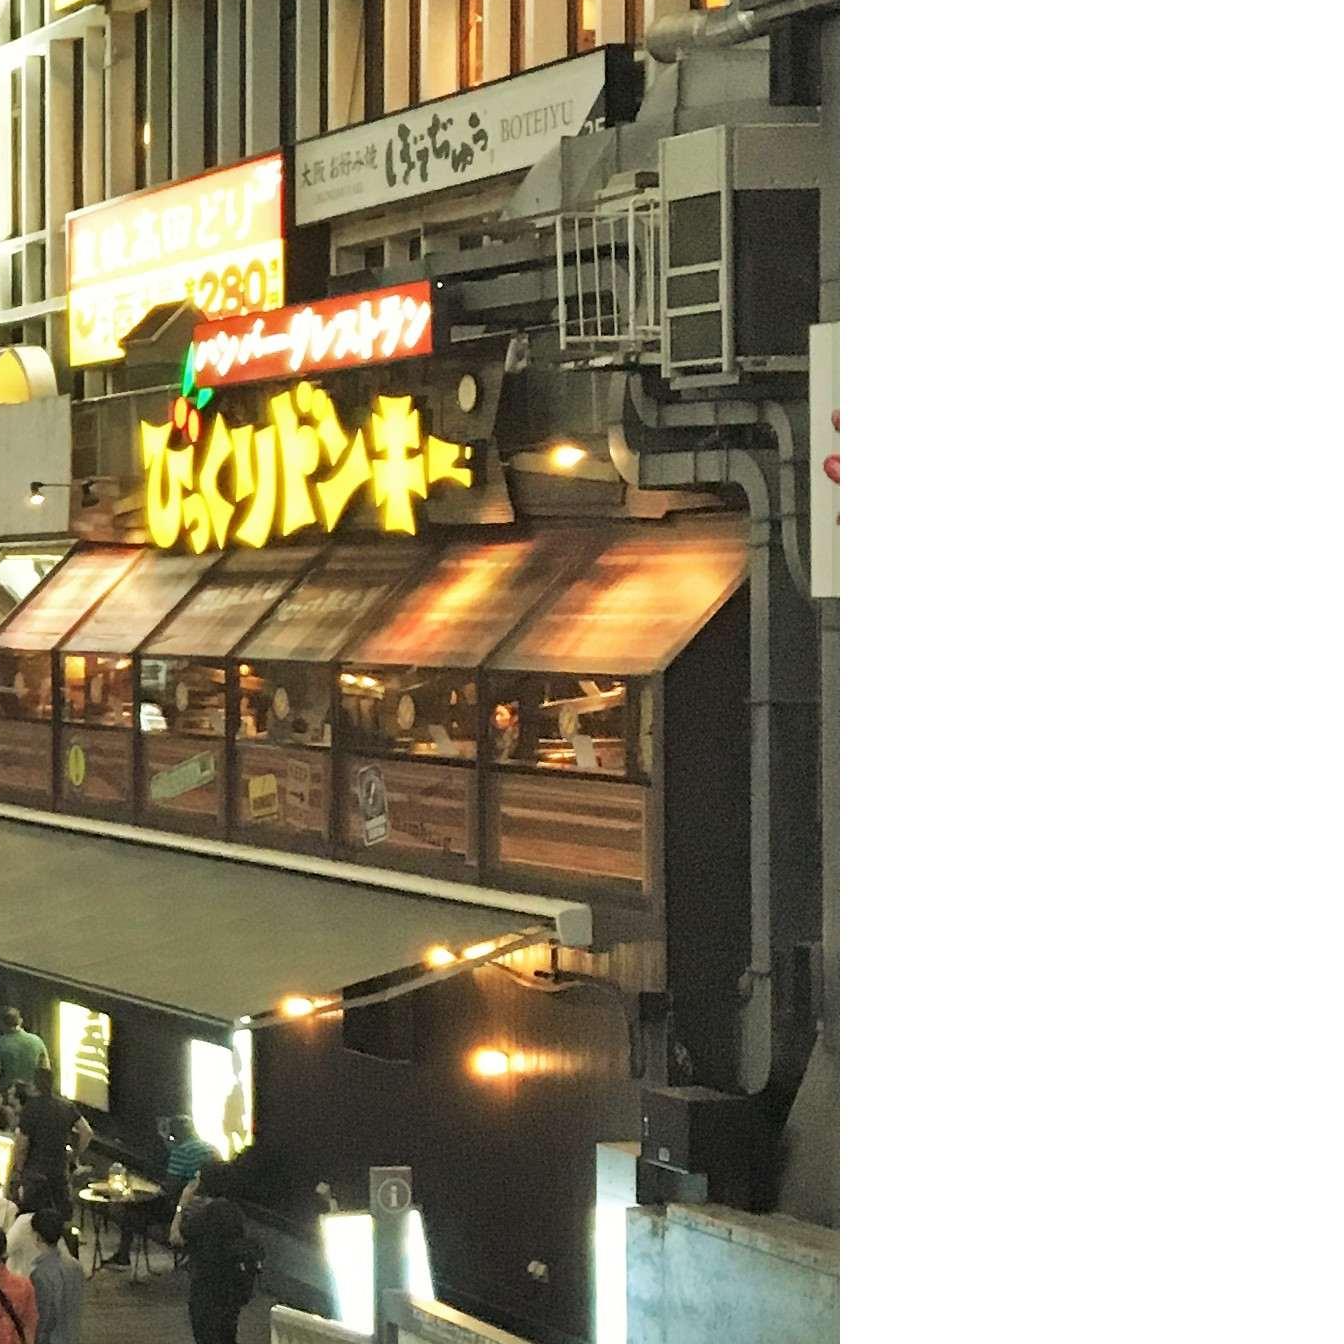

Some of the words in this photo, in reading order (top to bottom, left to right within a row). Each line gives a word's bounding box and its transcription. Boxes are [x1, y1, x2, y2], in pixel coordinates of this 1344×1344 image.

[499, 98, 575, 144] BOTEJYU
[139, 380, 474, 554] びっくりドンキー
